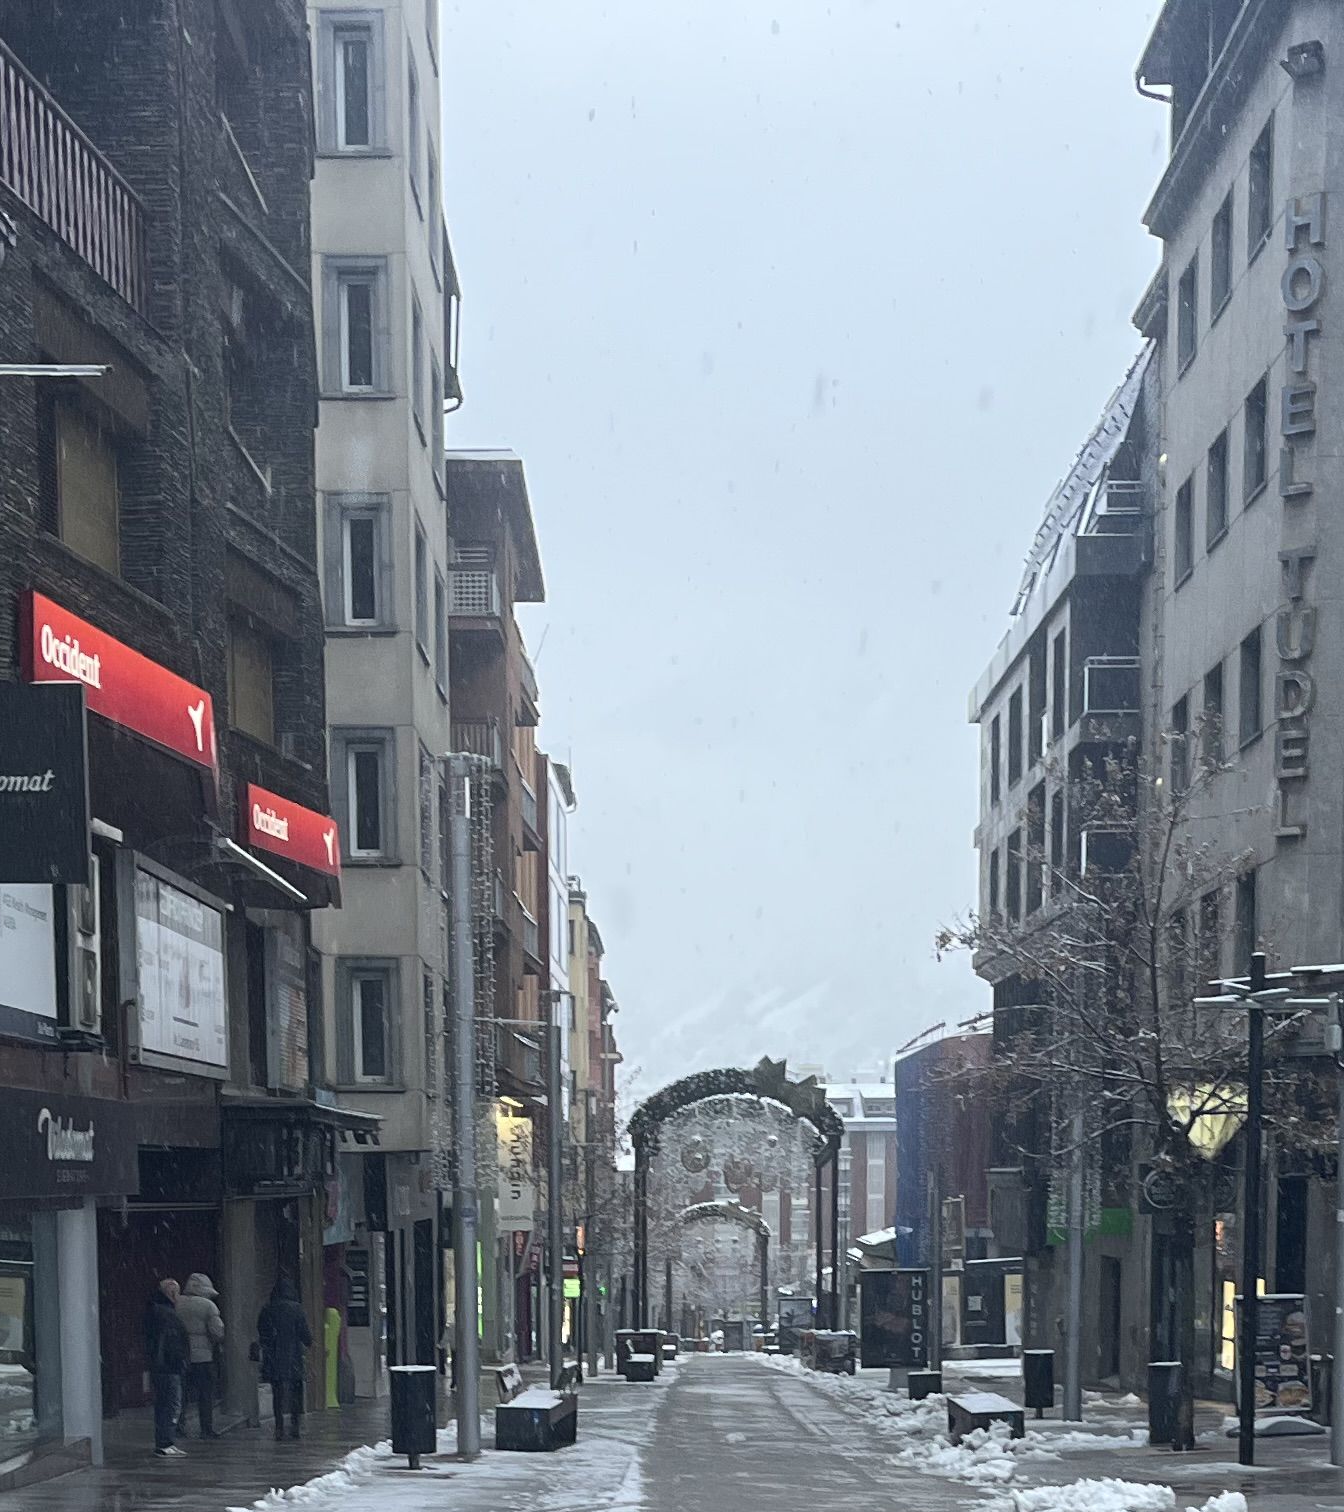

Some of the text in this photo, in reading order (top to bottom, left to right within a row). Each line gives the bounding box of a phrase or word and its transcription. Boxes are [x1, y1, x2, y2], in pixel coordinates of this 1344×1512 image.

[1279, 197, 1326, 498] HOTEL
[41, 624, 102, 689] Occident
[1276, 546, 1316, 837] TUDEL
[253, 803, 289, 842] Occident
[911, 1276, 923, 1358] HUBLOT
